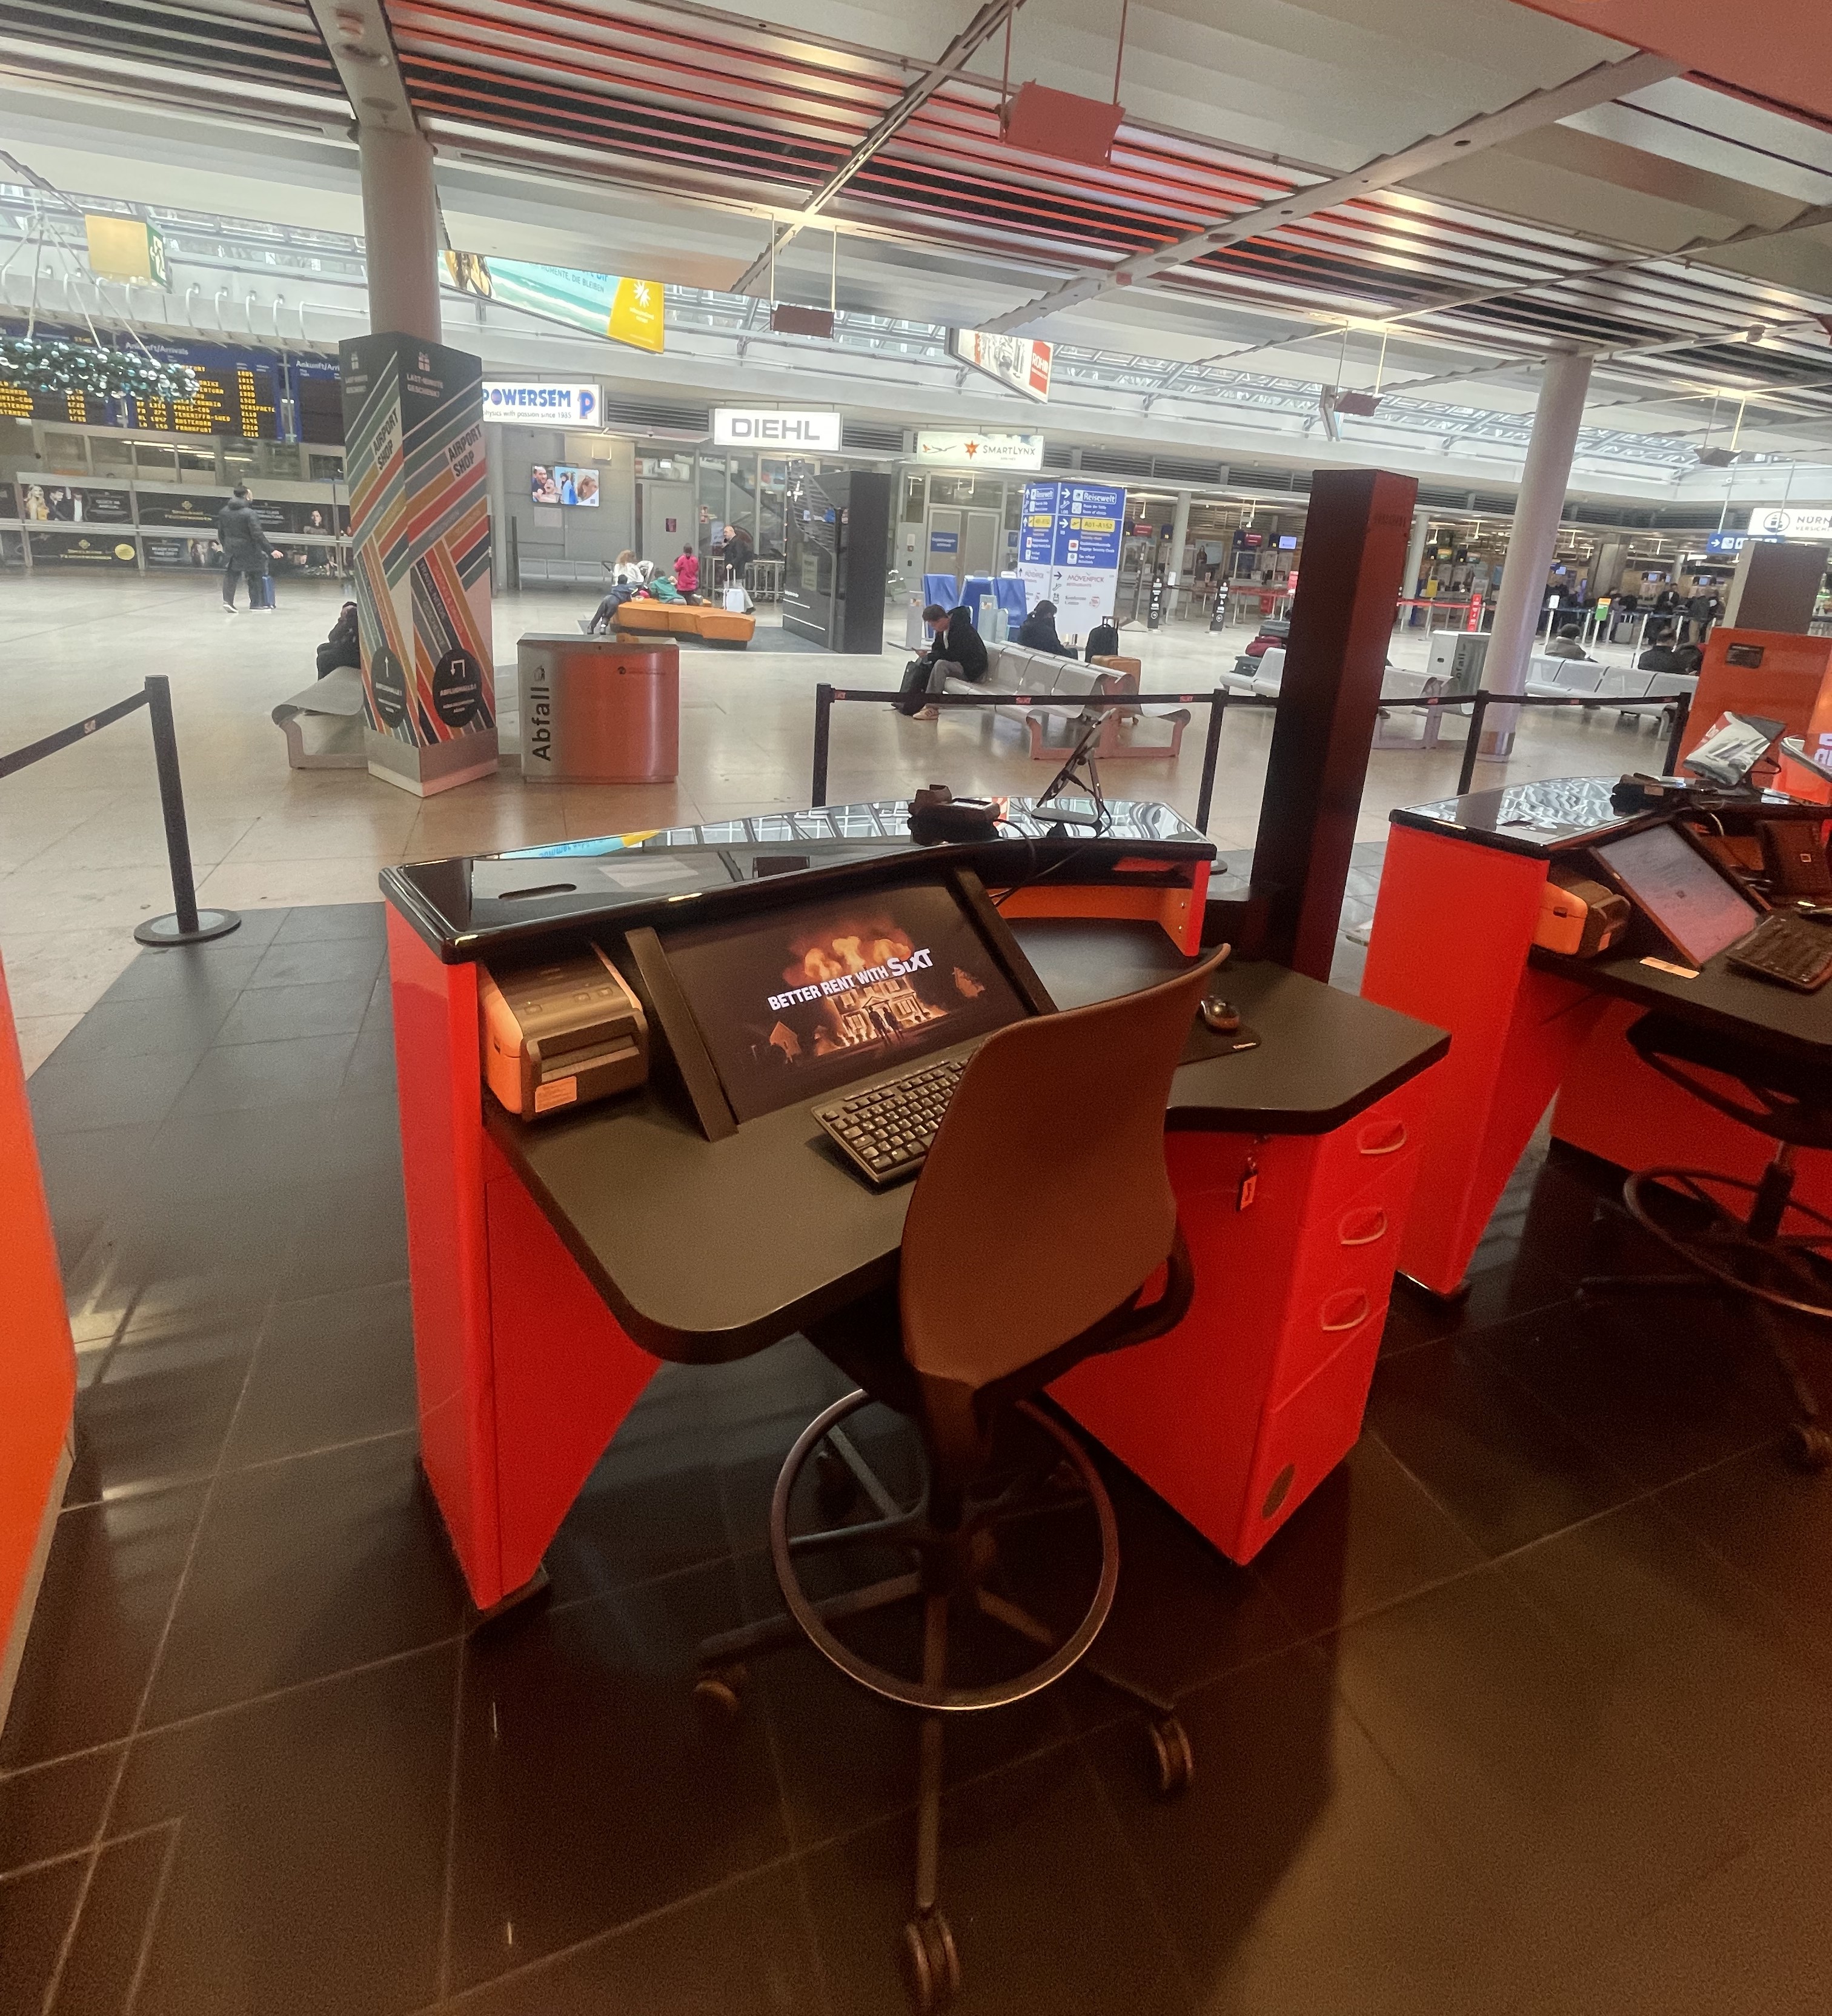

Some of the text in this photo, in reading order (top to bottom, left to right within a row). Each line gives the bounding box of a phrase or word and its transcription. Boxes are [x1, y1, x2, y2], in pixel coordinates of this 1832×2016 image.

[572, 274, 581, 285] DIE
[582, 279, 605, 293] BLEIBEN
[372, 408, 400, 456] AIRPORT
[447, 424, 483, 462] AIRPORT
[731, 418, 820, 440] DIEHL
[377, 439, 393, 470] SHOP
[453, 450, 475, 477] SHOP
[1083, 493, 1115, 503] Reisewelt
[1456, 653, 1465, 679] bfall
[530, 687, 551, 761] Abfall
[768, 984, 821, 1011] BETTER
[820, 975, 855, 995] RENT
[855, 966, 889, 985] WITH
